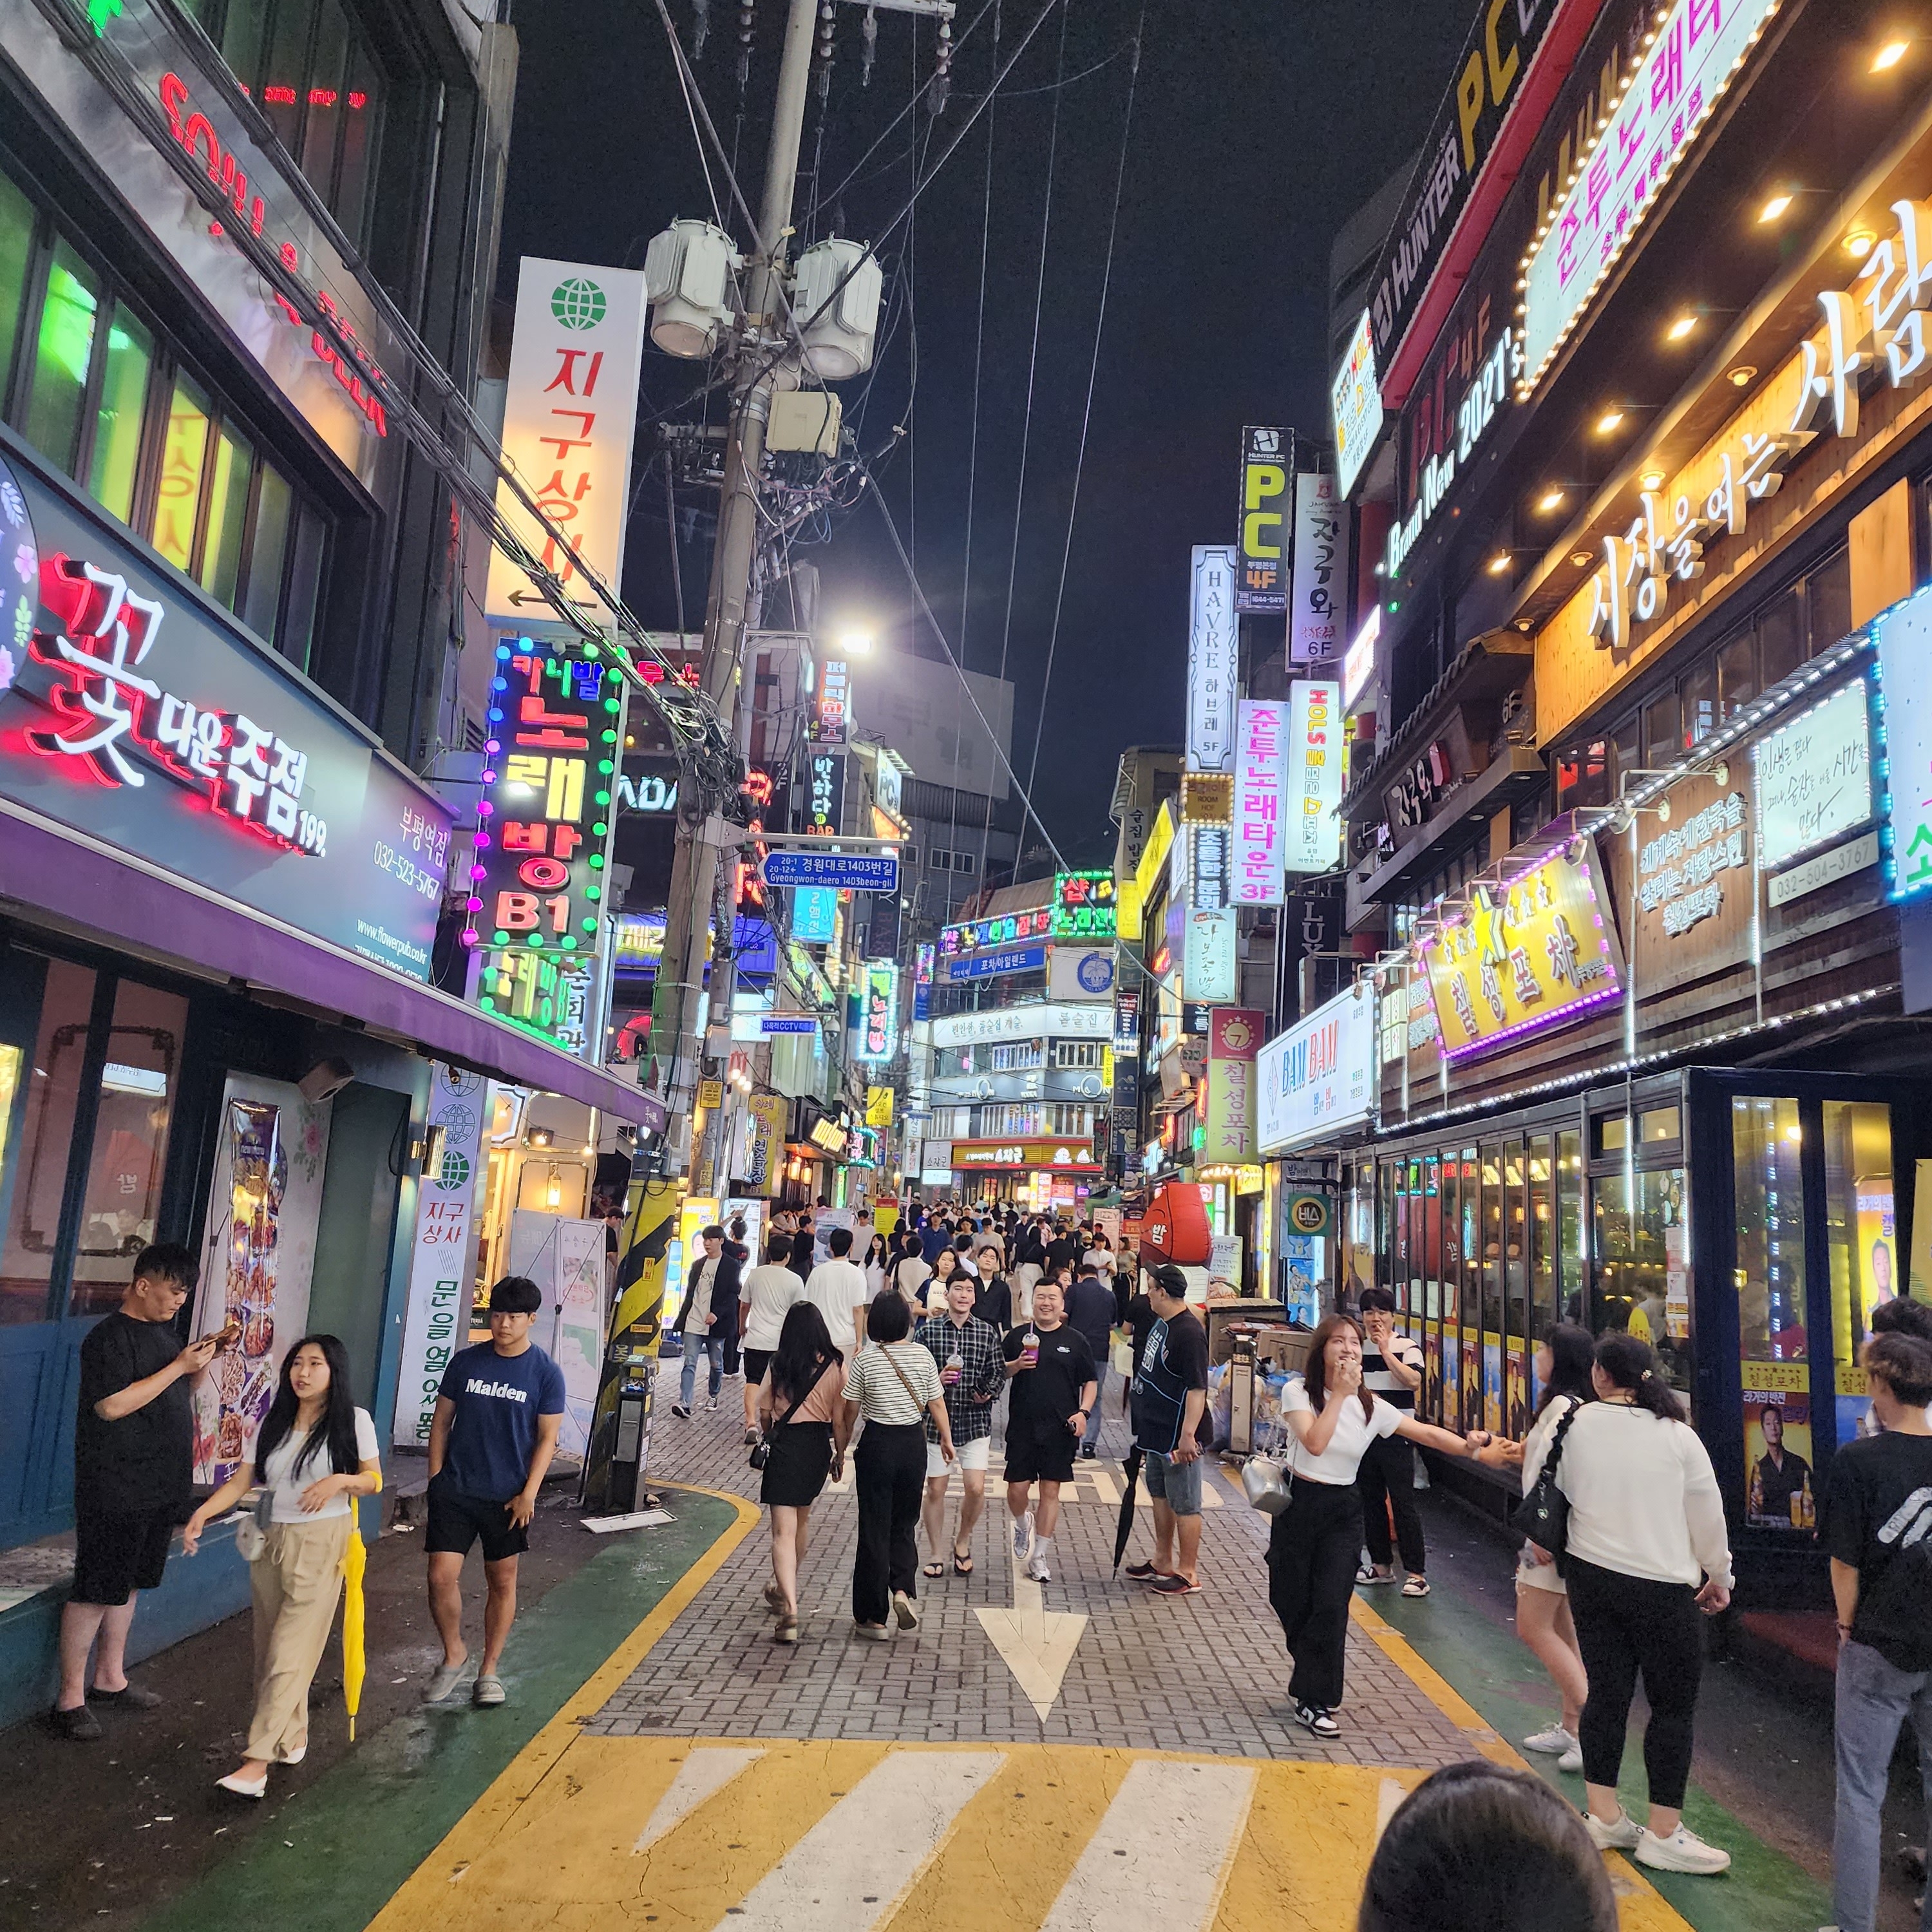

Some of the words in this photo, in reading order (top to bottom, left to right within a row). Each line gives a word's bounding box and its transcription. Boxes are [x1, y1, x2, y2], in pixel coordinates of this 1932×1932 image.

[1392, 137, 1461, 312] HUNTER
[1587, 491, 1699, 647] 시장을
[1708, 431, 1777, 531] 여는
[1791, 200, 1932, 438] 사람
[534, 348, 605, 581] 지구상사
[1388, 499, 1423, 578] Brand
[1423, 450, 1455, 520] New
[1458, 327, 1520, 464] 2021's
[1244, 464, 1285, 558] PC
[1247, 571, 1277, 589] 4F
[1205, 571, 1223, 669] HAVRE
[1308, 641, 1332, 656] 6F
[1204, 677, 1220, 732] 하브레
[1307, 689, 1329, 745] HOLS
[1202, 741, 1220, 752] 5F
[227, 712, 307, 838] 주점
[502, 696, 589, 887] 노래방
[812, 757, 835, 814] 반하다
[1240, 708, 1281, 880] 준투노래타운
[399, 806, 449, 867] 부평역점
[806, 825, 835, 836] BAR
[1696, 792, 1745, 844] 한국을
[374, 840, 440, 900] 032-523-5767
[770, 873, 840, 885] Gyeongwon-daero
[842, 876, 893, 889] 1403beon-gil
[781, 857, 797, 866] 20-1
[802, 858, 893, 876] 경원대로1403번길
[1776, 840, 1870, 899] 032-504-3767
[495, 891, 570, 933] B1
[1060, 907, 1117, 929] 노래연
[1240, 883, 1277, 901] 3F
[1451, 914, 1582, 1036] 칠성포차
[1282, 1039, 1307, 1098] BAM
[1309, 1019, 1339, 1085] BAM
[1222, 1063, 1251, 1154] 칠성포차
[422, 1224, 462, 1245] 상사
[424, 1202, 464, 1222] 지구
[1151, 1223, 1168, 1245] 밤
[464, 1378, 528, 1404] Malden
[1749, 1374, 1803, 1389] 칠성포차
